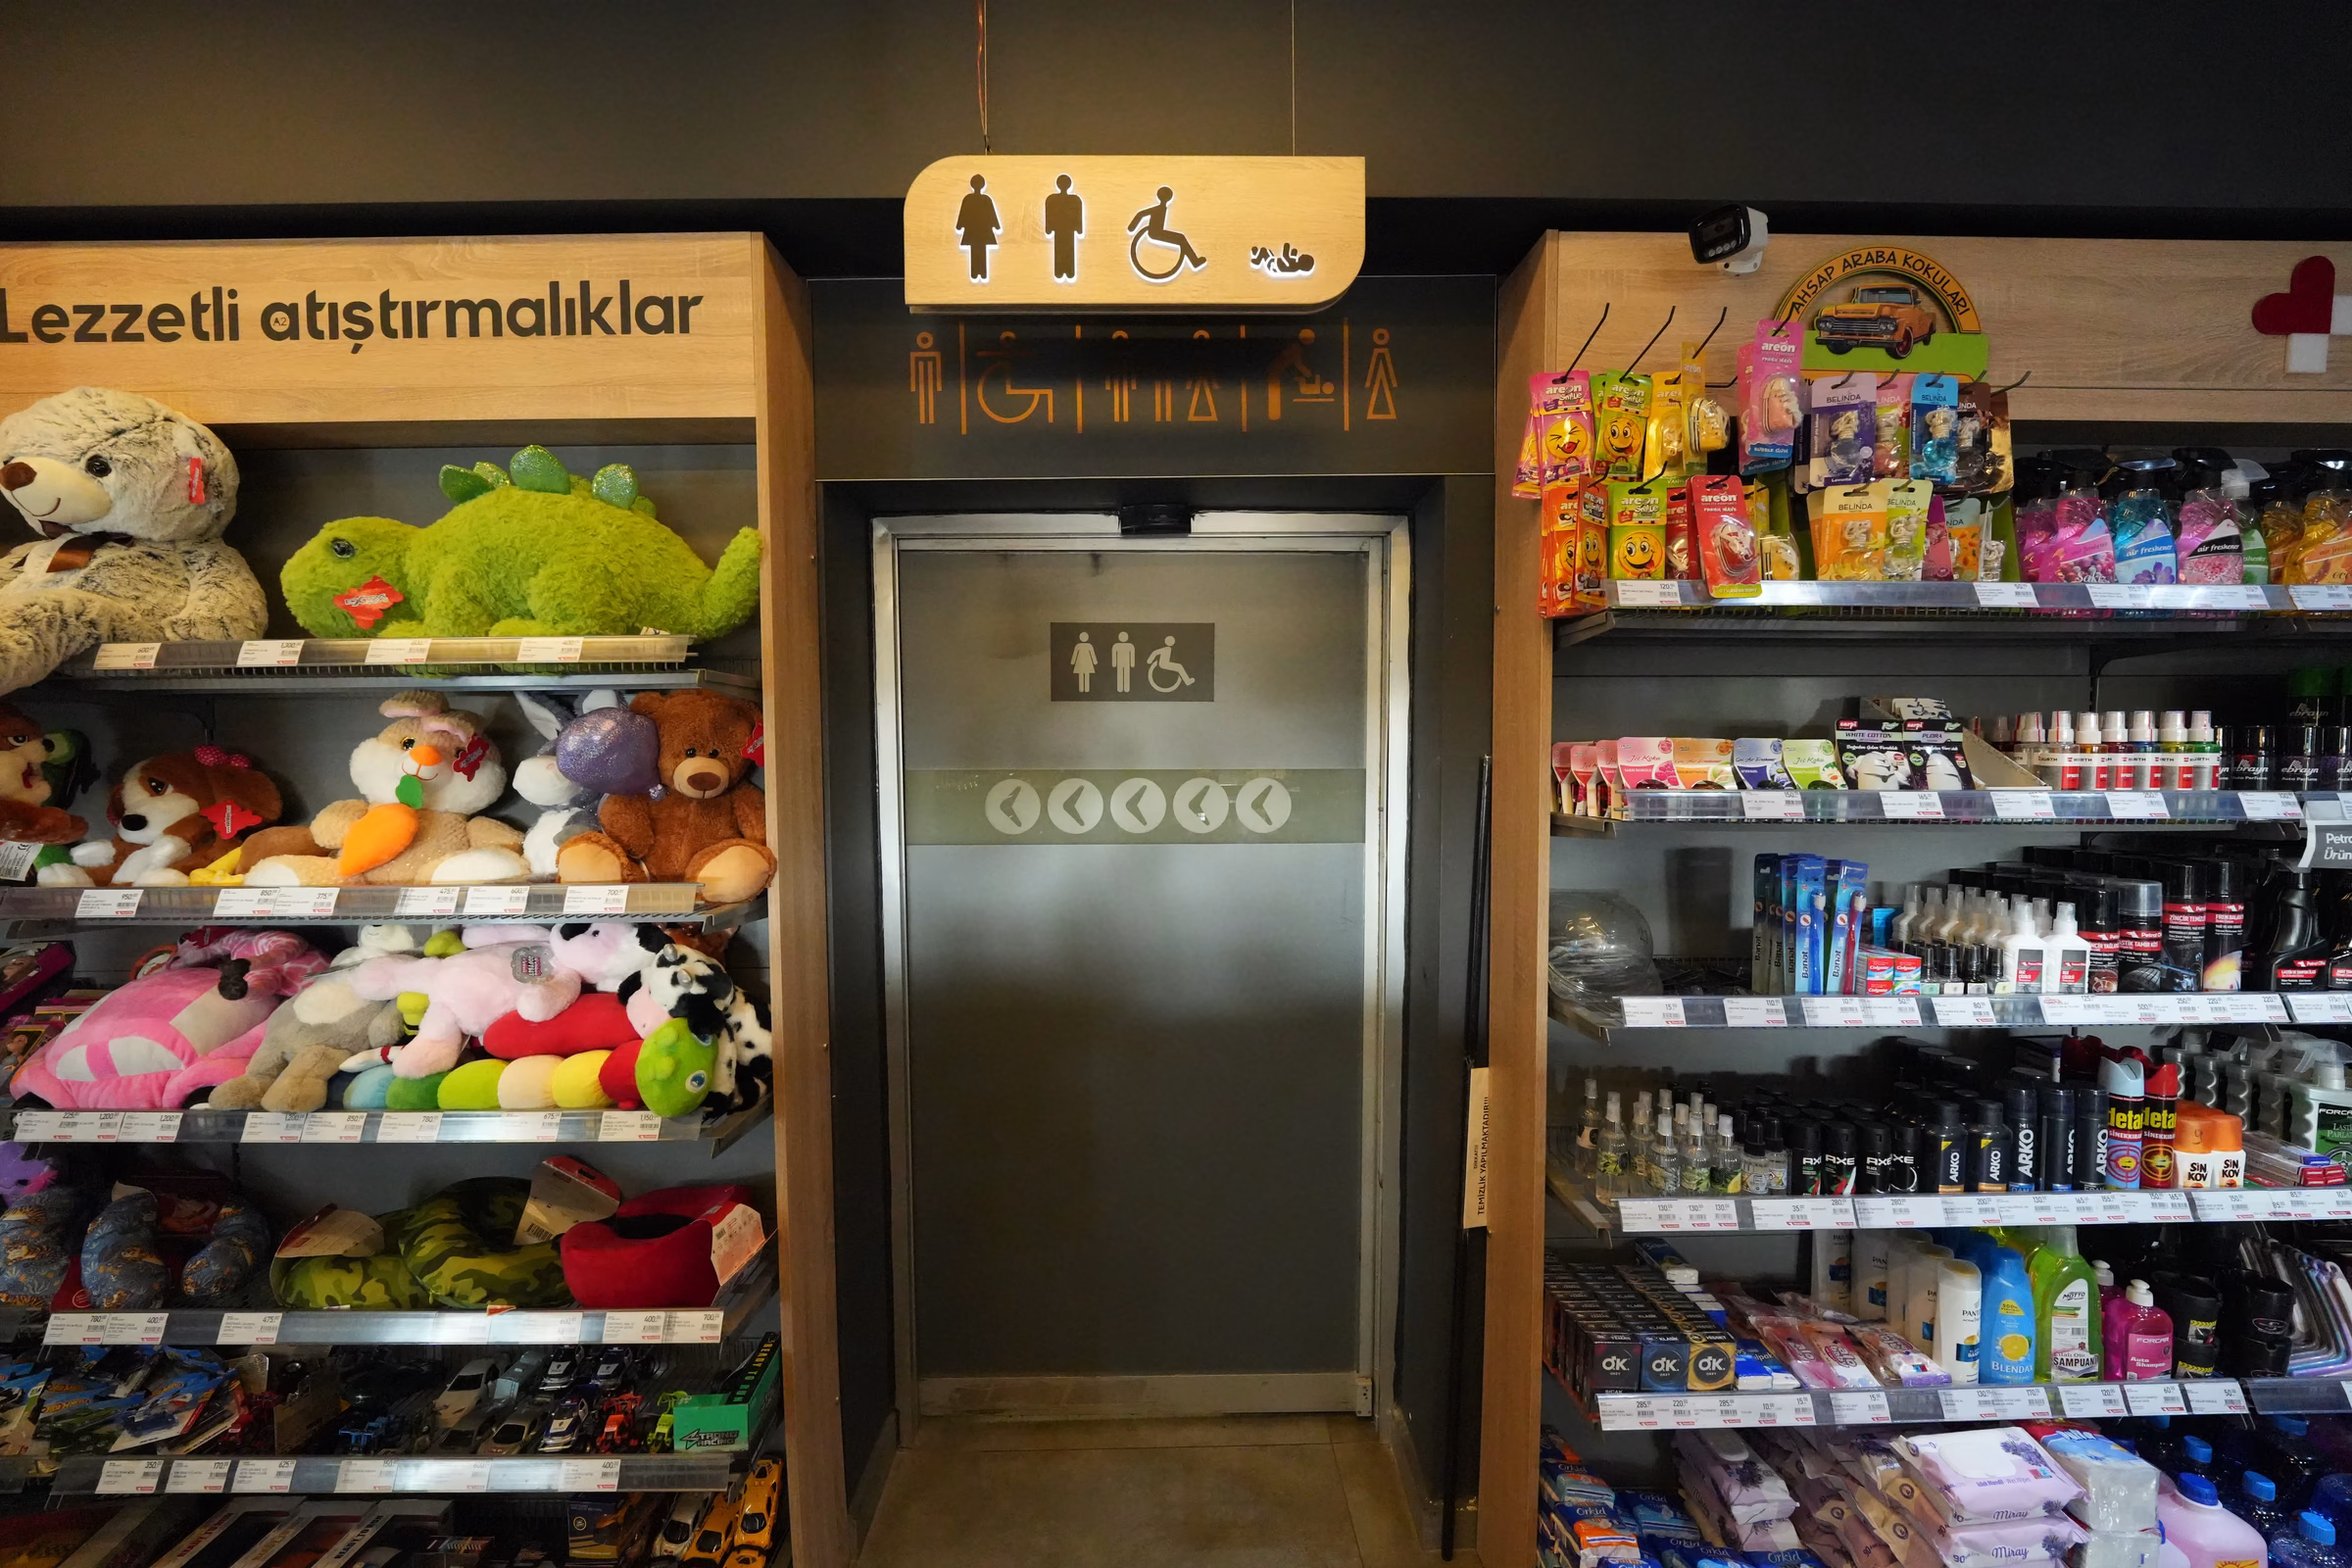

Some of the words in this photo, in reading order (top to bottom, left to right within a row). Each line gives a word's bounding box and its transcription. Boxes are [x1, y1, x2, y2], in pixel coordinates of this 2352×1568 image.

[1842, 250, 1896, 272] ARABA
[1902, 253, 1971, 316] KOKULARI
[0, 286, 239, 344] Lezzetli
[261, 279, 704, 354] atıştırmalıklar
[1762, 339, 1795, 353] areon
[1545, 383, 1583, 395] areon
[1611, 383, 1645, 397] areon
[1622, 497, 1658, 506] areon
[1701, 492, 1738, 503] areon
[2127, 548, 2139, 557] air
[2140, 544, 2174, 556] freshener
[2197, 544, 2209, 553] air
[2210, 543, 2240, 552] freshener
[1833, 950, 1842, 977] Banat
[2018, 1129, 2034, 1178] ARKO
[2096, 1129, 2108, 1176] ARKO
[1826, 1154, 1855, 1165] AXE
[1866, 1156, 1891, 1166] AXE
[1989, 1151, 2001, 1181] ARKO
[1949, 1152, 1960, 1183] ARKO
[2222, 1168, 2239, 1179] KOV
[2187, 1171, 2208, 1182] KOV
[1478, 1175, 1487, 1215] TEMİZLİK
[753, 1344, 773, 1367] READY
[1991, 1361, 2034, 1374] BLENDAX
[1640, 1493, 1667, 1502] Orkid
[1576, 1506, 1607, 1518] Orkid
[1992, 1510, 2030, 1520] Miray
[334, 1539, 359, 1560] READY
[1669, 1538, 1700, 1548] Orkid
[1700, 1546, 1731, 1558] Orkid
[1767, 1550, 1801, 1566] Orkid
[1991, 1545, 2029, 1559] Miray
